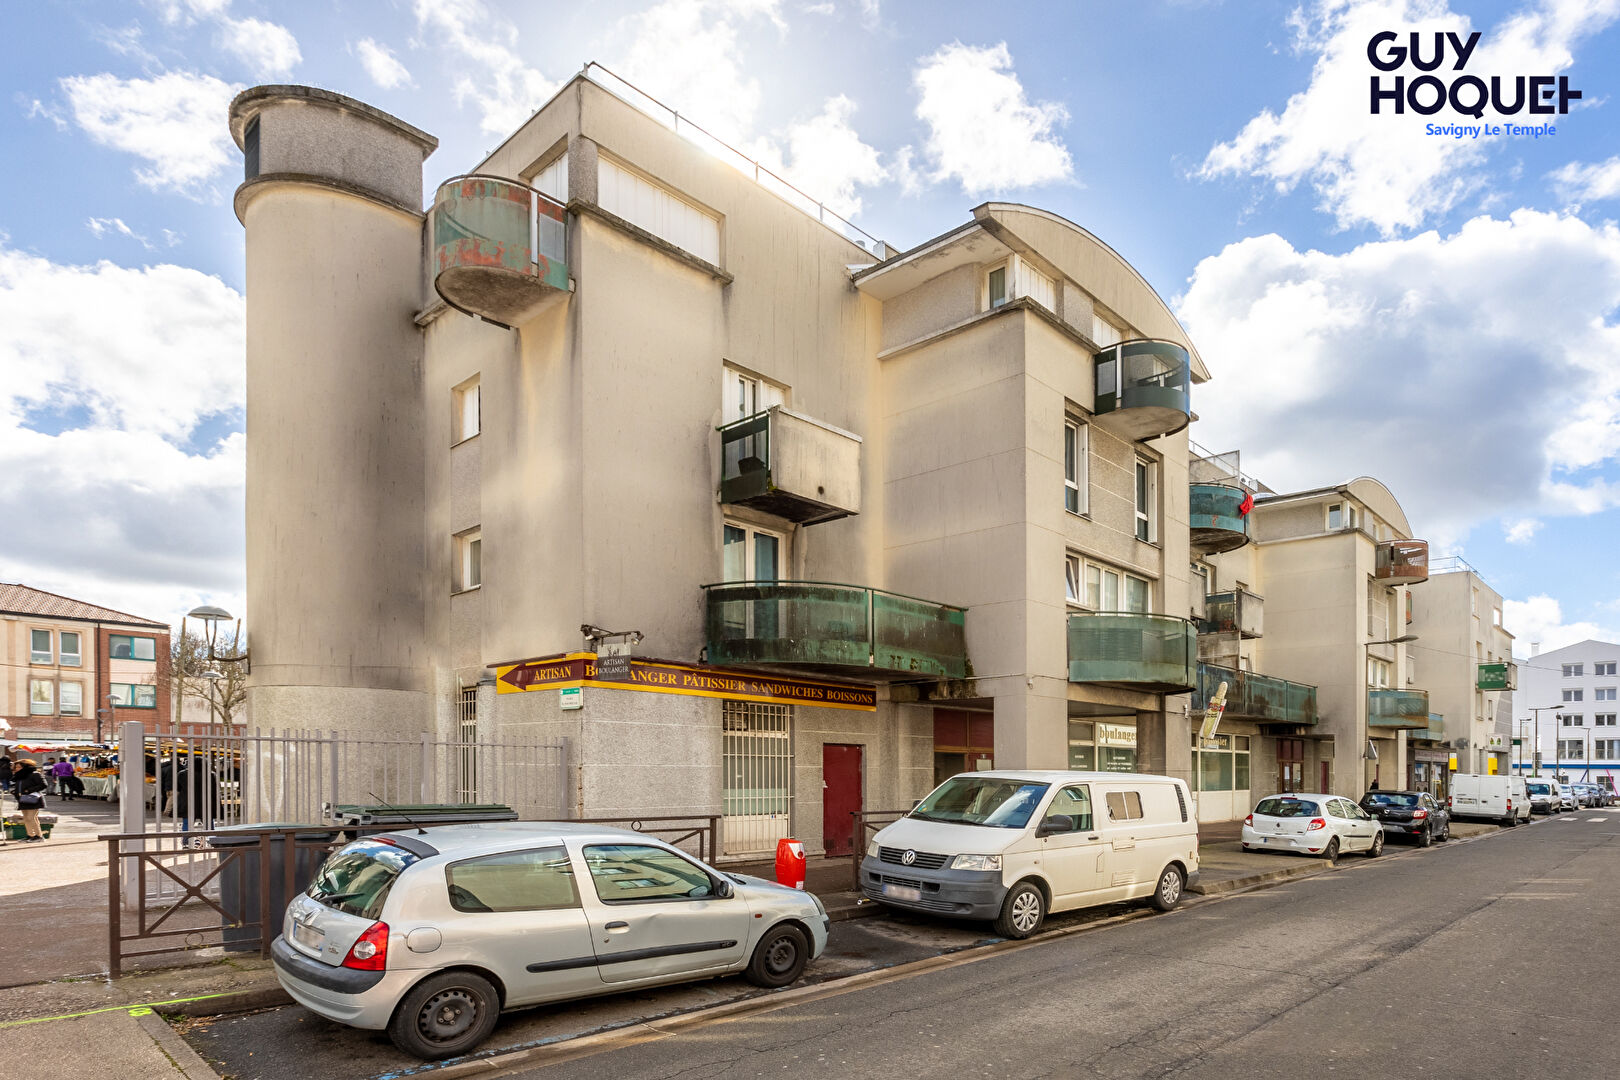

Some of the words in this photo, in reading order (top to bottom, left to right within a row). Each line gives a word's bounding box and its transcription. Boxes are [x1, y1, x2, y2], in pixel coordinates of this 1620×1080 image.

[603, 658, 625, 666] ARTISAN
[599, 665, 629, 673] BOULANGER
[534, 665, 572, 681] ARTISAN
[585, 664, 677, 685] BANGER
[683, 673, 746, 691] PÂTISSIER
[751, 682, 824, 698] SANDWICHES
[827, 691, 873, 704] BOISSONS
[1099, 726, 1136, 742] boulange
